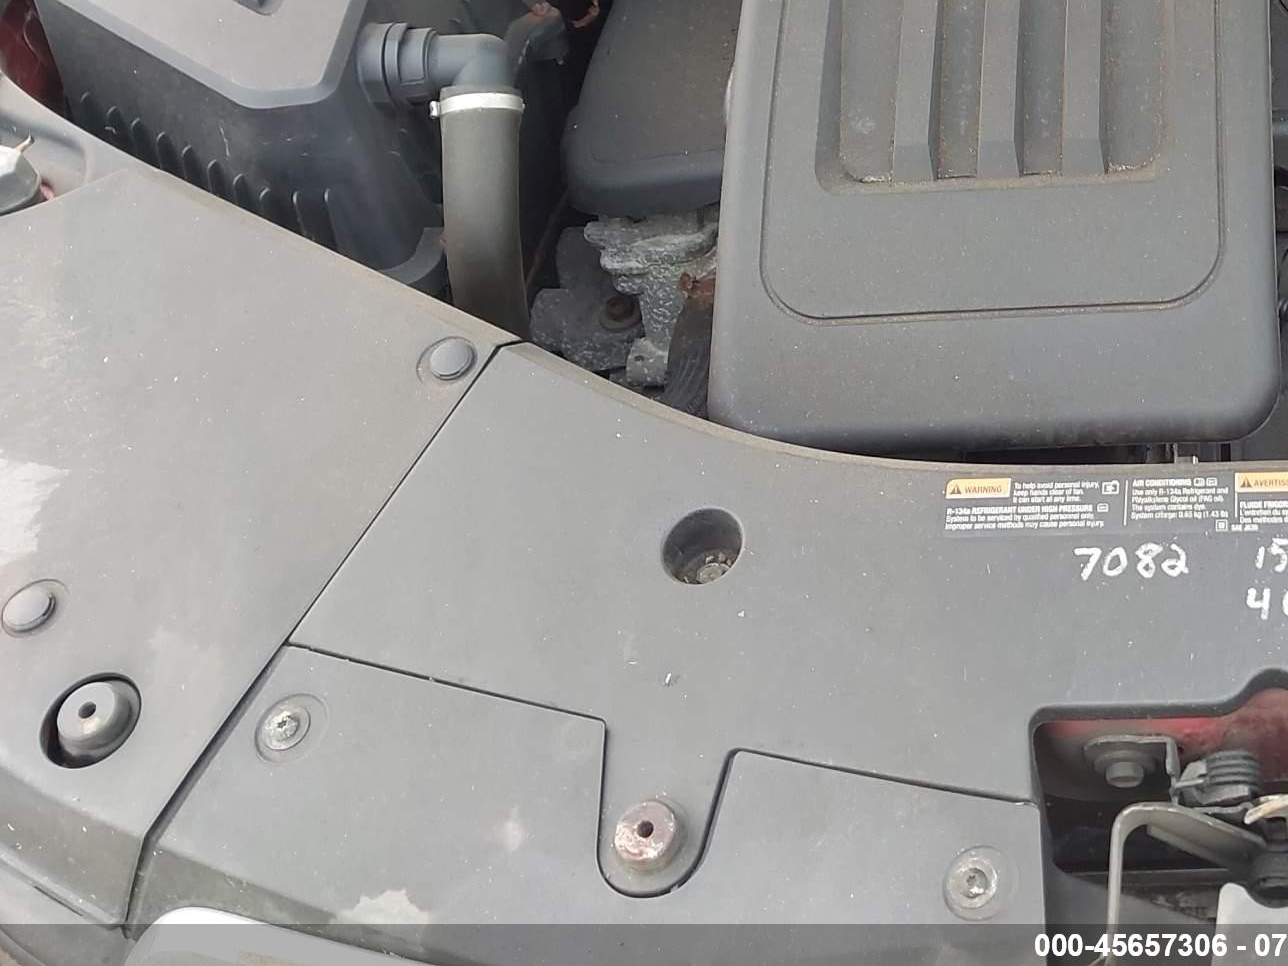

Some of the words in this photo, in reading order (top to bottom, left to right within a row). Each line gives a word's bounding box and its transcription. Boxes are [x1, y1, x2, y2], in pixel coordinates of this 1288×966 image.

[964, 485, 1002, 494] WARNING
[1022, 482, 1036, 490] help
[1054, 482, 1080, 490] personal
[1059, 520, 1085, 528] personal
[1073, 542, 1189, 581] 7082
[1246, 587, 1271, 620] 4
